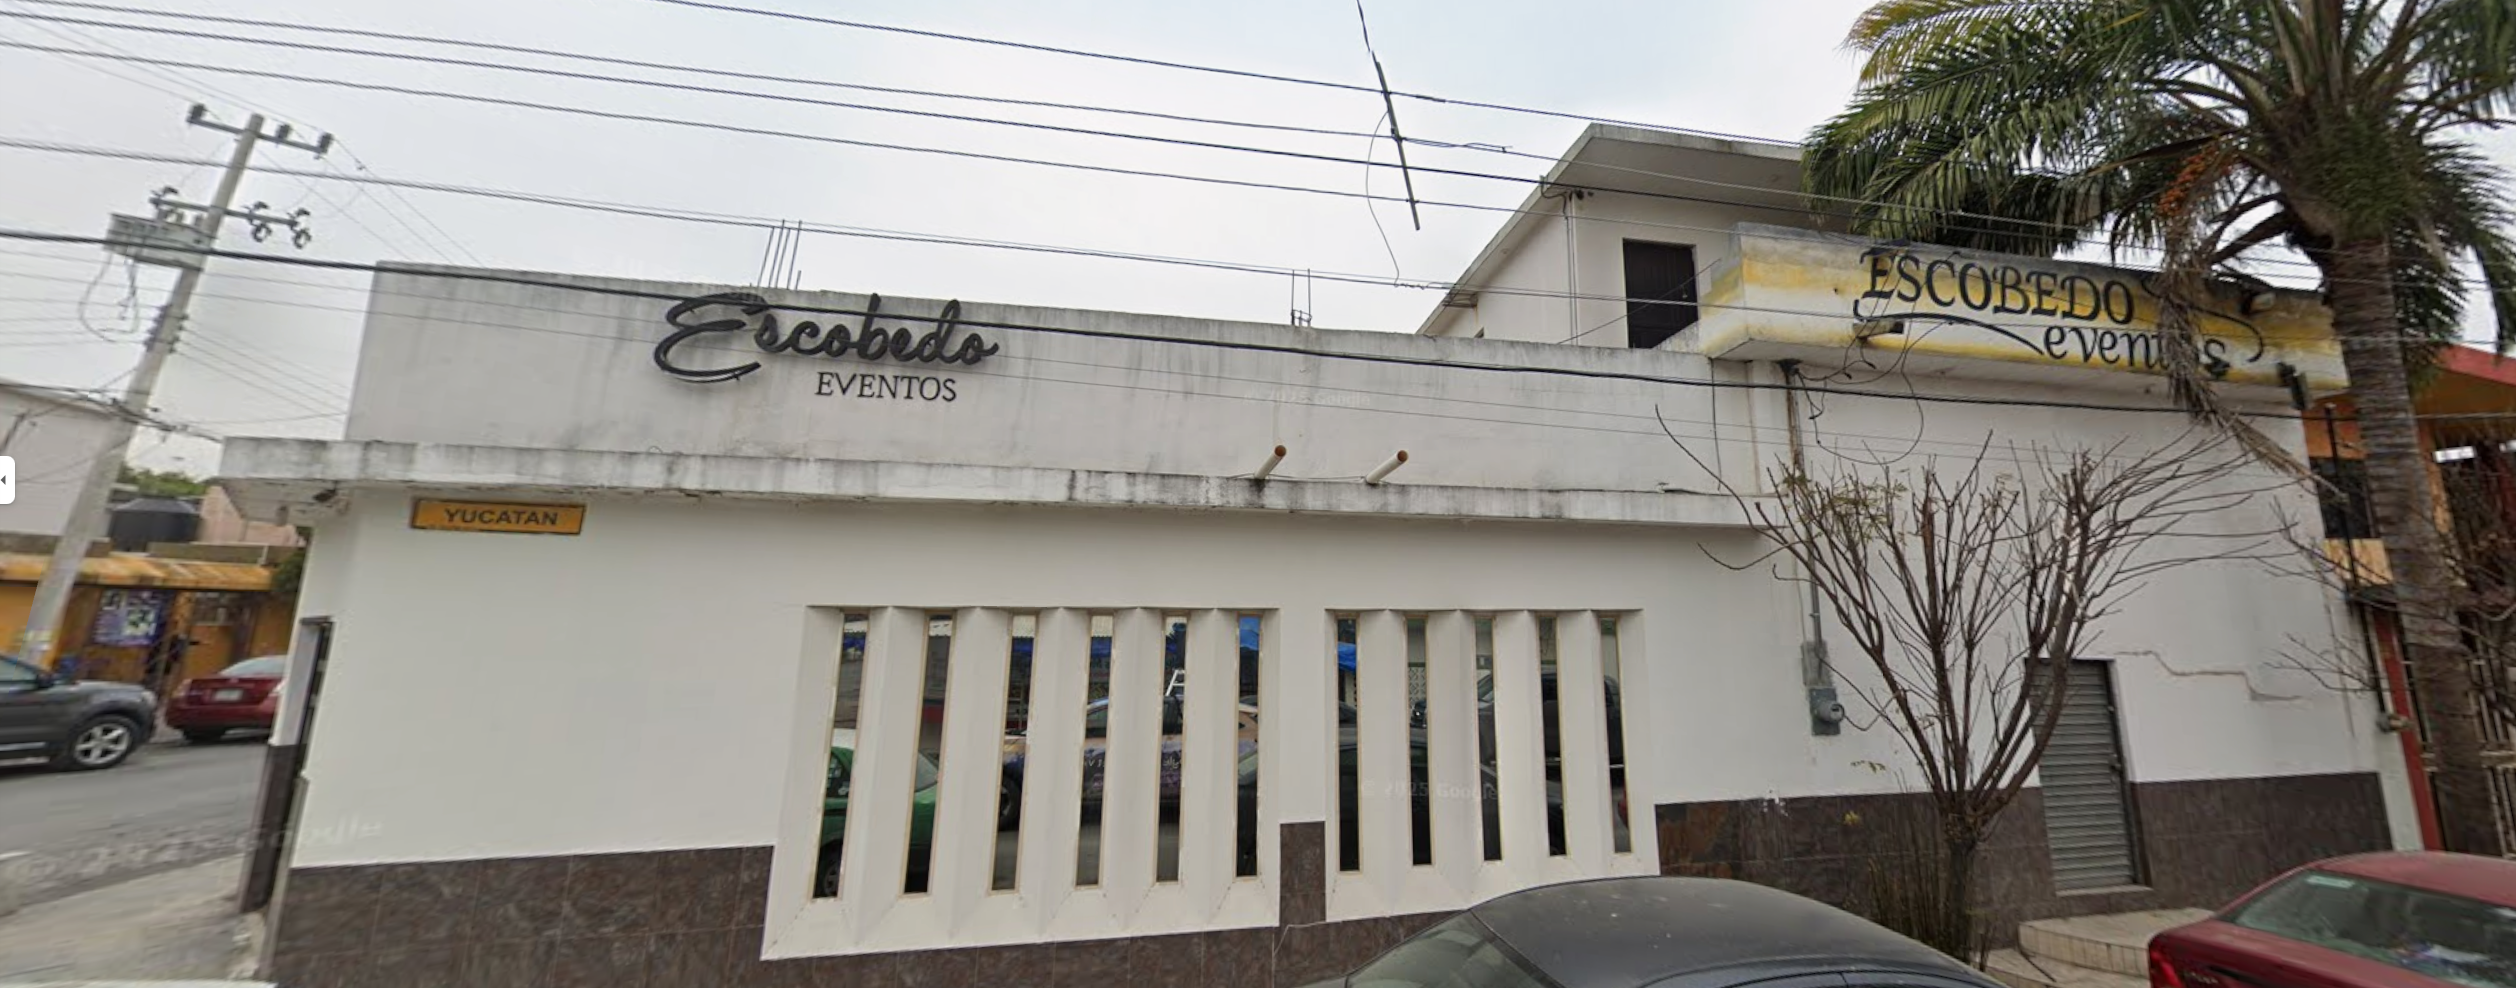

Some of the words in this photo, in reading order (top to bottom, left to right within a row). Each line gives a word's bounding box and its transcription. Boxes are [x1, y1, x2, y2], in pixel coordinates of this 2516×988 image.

[1860, 248, 2135, 325] ESCOBEDO
[653, 292, 999, 383] Escobedo
[2044, 325, 2228, 376] events
[815, 371, 957, 402] EVENTOS
[444, 507, 558, 526] YUCATAN
